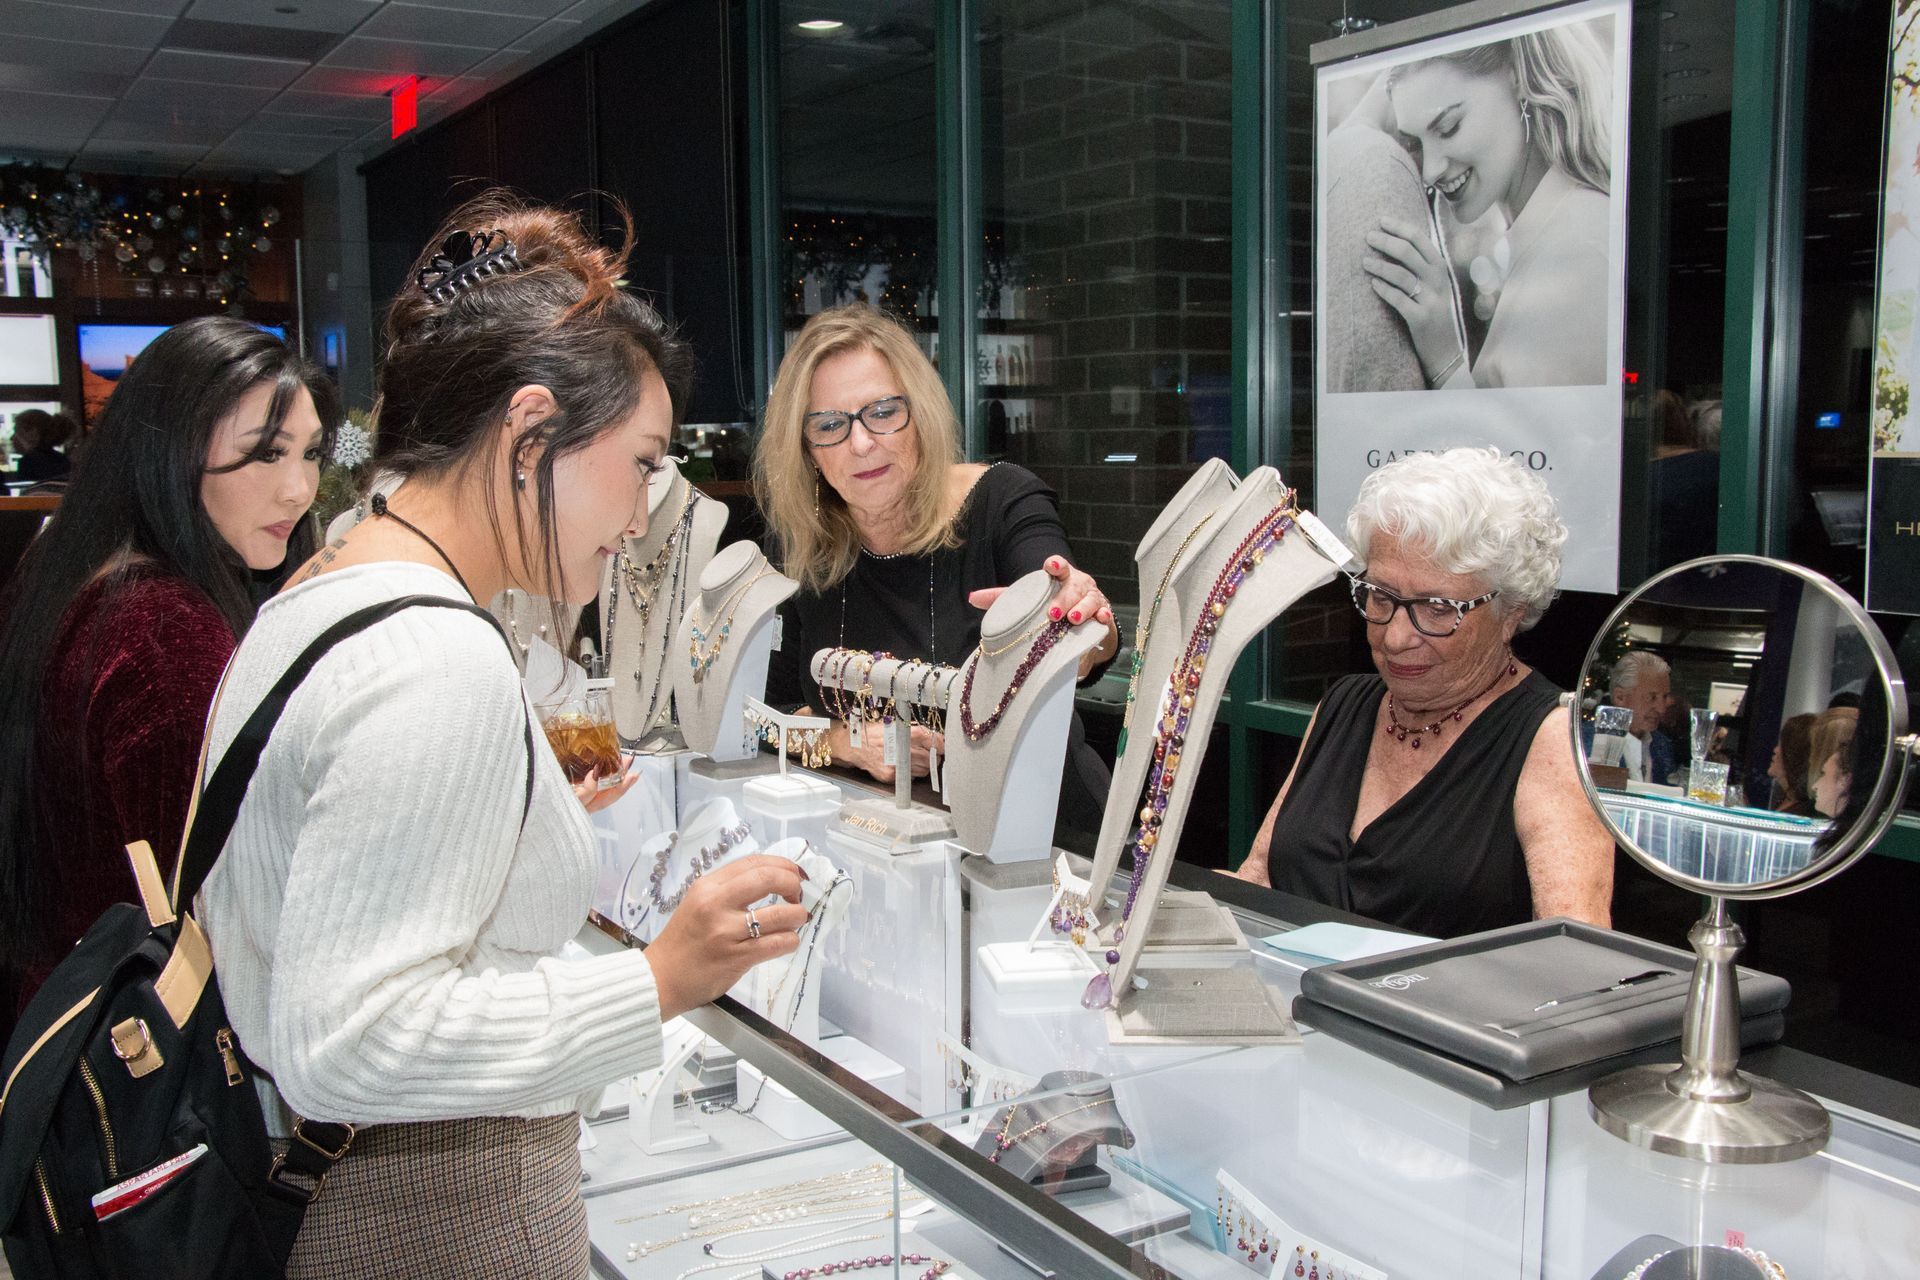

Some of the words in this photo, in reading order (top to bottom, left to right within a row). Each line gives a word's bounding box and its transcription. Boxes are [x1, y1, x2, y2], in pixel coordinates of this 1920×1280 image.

[845, 812, 865, 827] Jan
[864, 817, 888, 836] Rich
[116, 1162, 169, 1191] ASPARTAME
